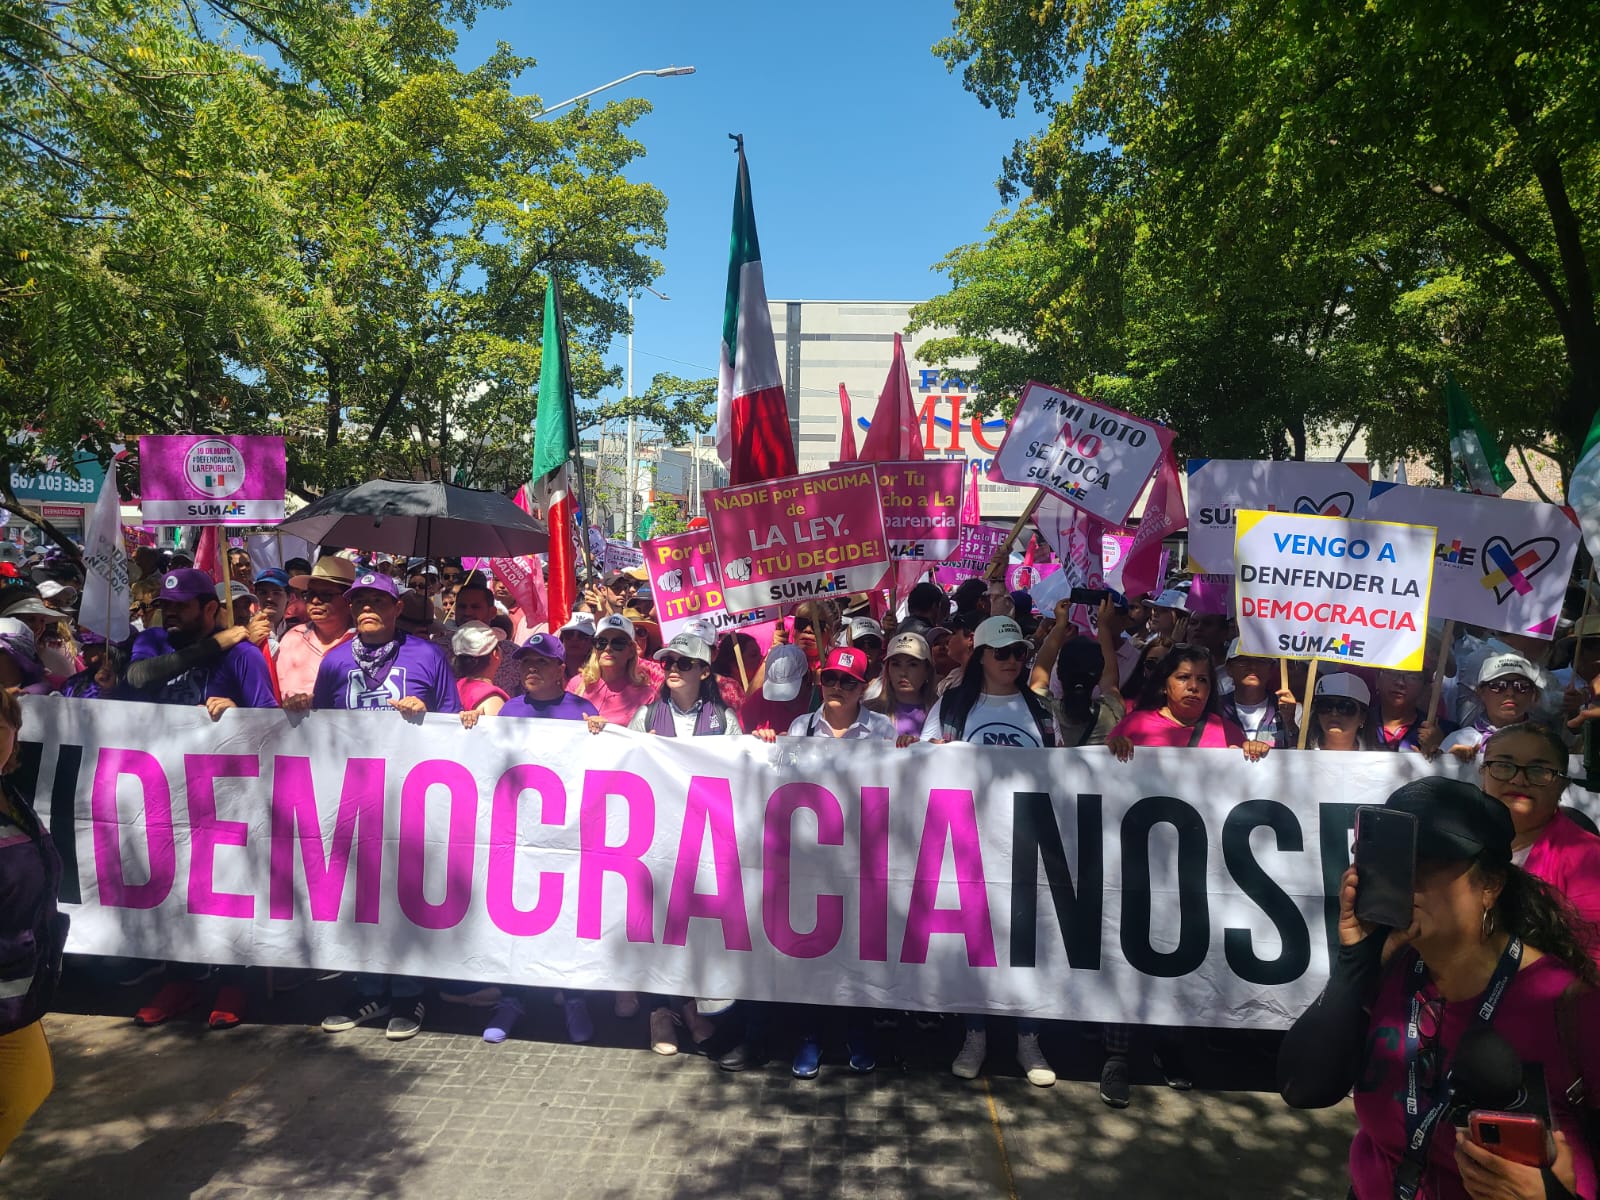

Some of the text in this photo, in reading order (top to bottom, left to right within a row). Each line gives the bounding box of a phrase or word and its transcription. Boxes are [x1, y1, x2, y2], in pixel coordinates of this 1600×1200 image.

[1055, 422, 1103, 458] NO
[1088, 413, 1147, 447] VOTO
[880, 470, 925, 487] or Tu
[1026, 441, 1111, 491] SE TOCA
[38, 475, 62, 492] 103
[714, 472, 872, 512] NADIE por ENCIMA
[883, 490, 955, 508] cho a La
[786, 503, 806, 517] de
[748, 513, 850, 551] LA LEY.
[1273, 532, 1397, 563] VENGO A
[658, 545, 692, 565] Por
[698, 541, 713, 556] u
[756, 540, 880, 576] ¡TÚ DECIDE!
[688, 561, 719, 588] LI
[1240, 564, 1385, 595] DENFENDER
[1391, 577, 1420, 598] LA
[666, 590, 723, 617] ¡TÚ D
[1242, 596, 1417, 632] DEMOCRACIA
[91, 747, 998, 968] DEMOCRACIA
